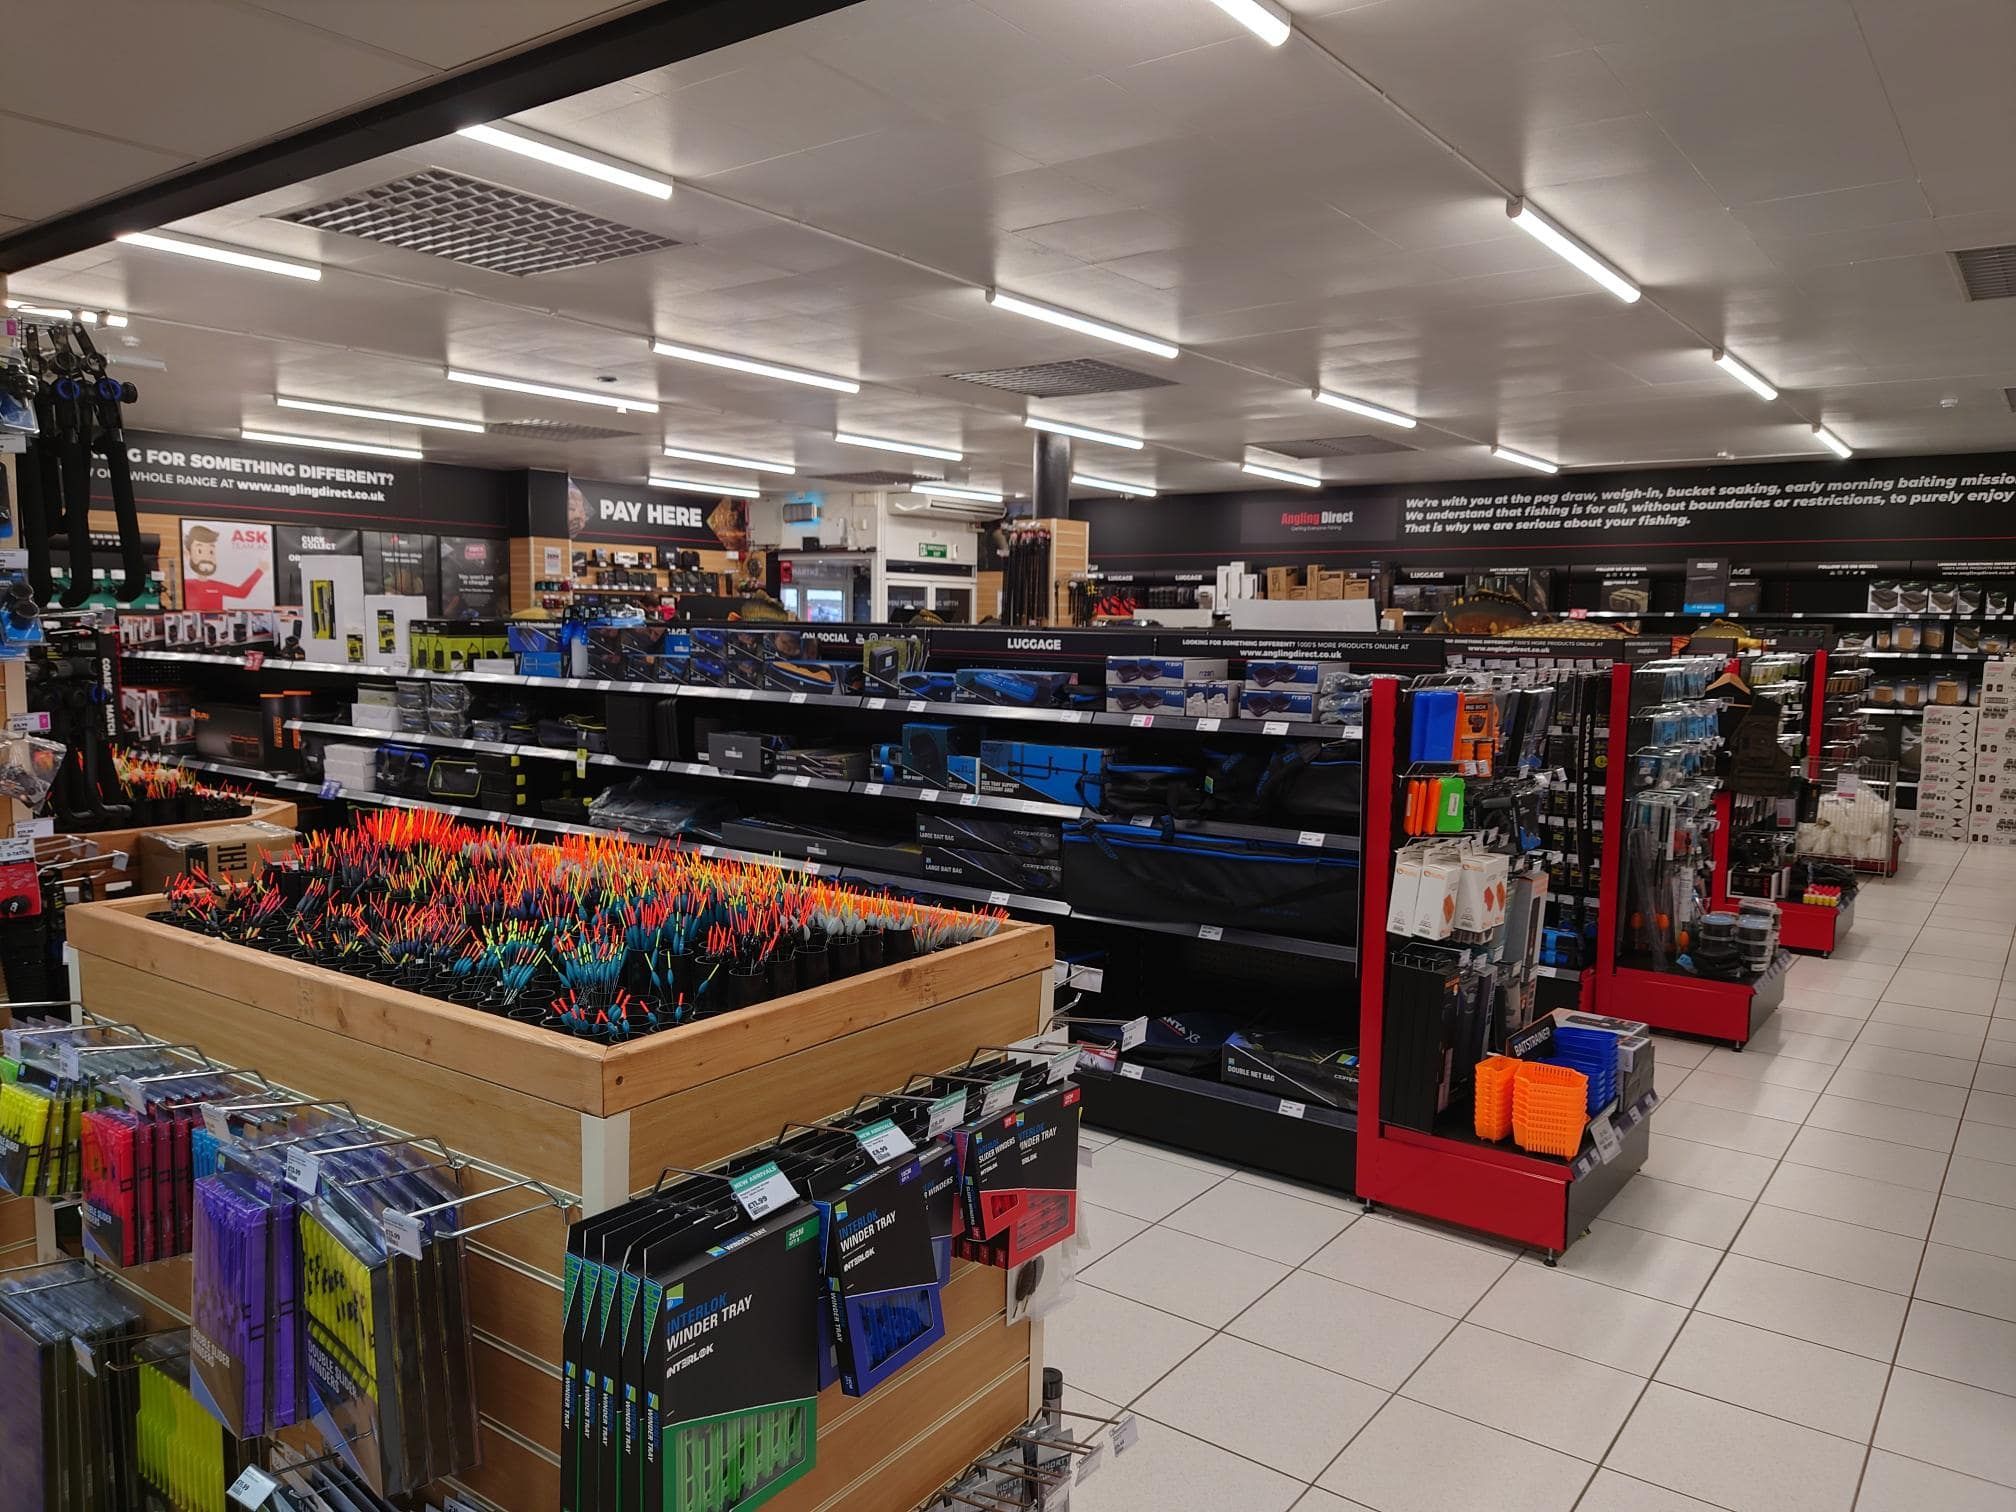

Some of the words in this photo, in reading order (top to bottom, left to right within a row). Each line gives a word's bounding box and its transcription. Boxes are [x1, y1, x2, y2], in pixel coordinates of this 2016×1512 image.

[147, 449, 186, 466] FOR
[190, 453, 295, 477] SOMETHING
[299, 465, 394, 486] DIFFERENT?
[130, 471, 173, 484] WHOLE
[176, 475, 218, 488] RANGE
[220, 478, 234, 489] AT
[236, 480, 386, 502] www.anglingdirect.co.uk
[1405, 498, 1439, 508] We're
[1441, 496, 1468, 507] with
[1469, 497, 1494, 508] you
[1494, 496, 1508, 505] at
[1510, 493, 1532, 504] the
[1533, 494, 1559, 506] peg
[1561, 491, 1598, 501] draw,
[1601, 487, 1664, 502] weigh-in,
[1666, 485, 1715, 497] bucket
[1719, 482, 1782, 496] soaking,
[1784, 481, 1824, 494] early
[1827, 478, 1895, 491] morning
[1897, 475, 1958, 489] baiting
[600, 500, 642, 522] PAY
[647, 503, 703, 527] HERE
[1281, 512, 1320, 525] Angling
[1321, 511, 1353, 524] Direct
[1405, 511, 1424, 521] We
[1426, 507, 1494, 520] understand
[1495, 507, 1522, 517] that
[1524, 505, 1569, 518] fishing
[1571, 504, 1583, 514] is
[1585, 503, 1604, 514] for
[1607, 503, 1628, 515] all,
[1632, 501, 1686, 513] without
[1688, 497, 1770, 511] boundaries
[1773, 499, 1791, 508] or
[1793, 493, 1886, 508] restrictions,
[1889, 493, 1907, 504] to
[1909, 491, 1964, 505] purely
[1966, 488, 2015, 503] enjoy
[232, 530, 268, 544] ASK
[1404, 523, 1430, 533] That
[1432, 522, 1443, 532] is
[1445, 521, 1471, 533] why
[1472, 523, 1491, 531] we
[1493, 522, 1513, 530] are
[1515, 519, 1561, 530] serious
[1563, 517, 1602, 528] about
[1604, 517, 1637, 529] your
[1638, 514, 1691, 527] fishing.
[817, 632, 849, 643] SOCIAL
[1007, 638, 1062, 651] LUGGAGE
[1240, 649, 1342, 659] www.anglingdirect.co.uk
[105, 703, 116, 737] MATCH
[1513, 1026, 1551, 1057] BAITSTRAINER
[1227, 1065, 1250, 1077] DOUBLE
[1250, 1069, 1262, 1080] NET
[1262, 1072, 1275, 1083] BAG
[1041, 1126, 1058, 1141] TRAY
[733, 1178, 749, 1190] NEW
[749, 1166, 777, 1183] ARRIVALS
[928, 1175, 954, 1197] WINDERS
[838, 1208, 879, 1240] INTERLOK
[840, 1223, 875, 1253] WINDER
[876, 1210, 897, 1230] TRAY
[724, 1234, 751, 1251] WINDER
[666, 1291, 728, 1337] INTERLOK
[666, 1313, 718, 1352] WINDER
[721, 1294, 753, 1323] TRAY
[210, 1345, 230, 1369] SLIDER
[307, 1340, 334, 1374] DOUBLE
[334, 1367, 357, 1397] SLIDER
[666, 1342, 714, 1379] INTERLOK
[308, 1354, 340, 1395] WINDERS
